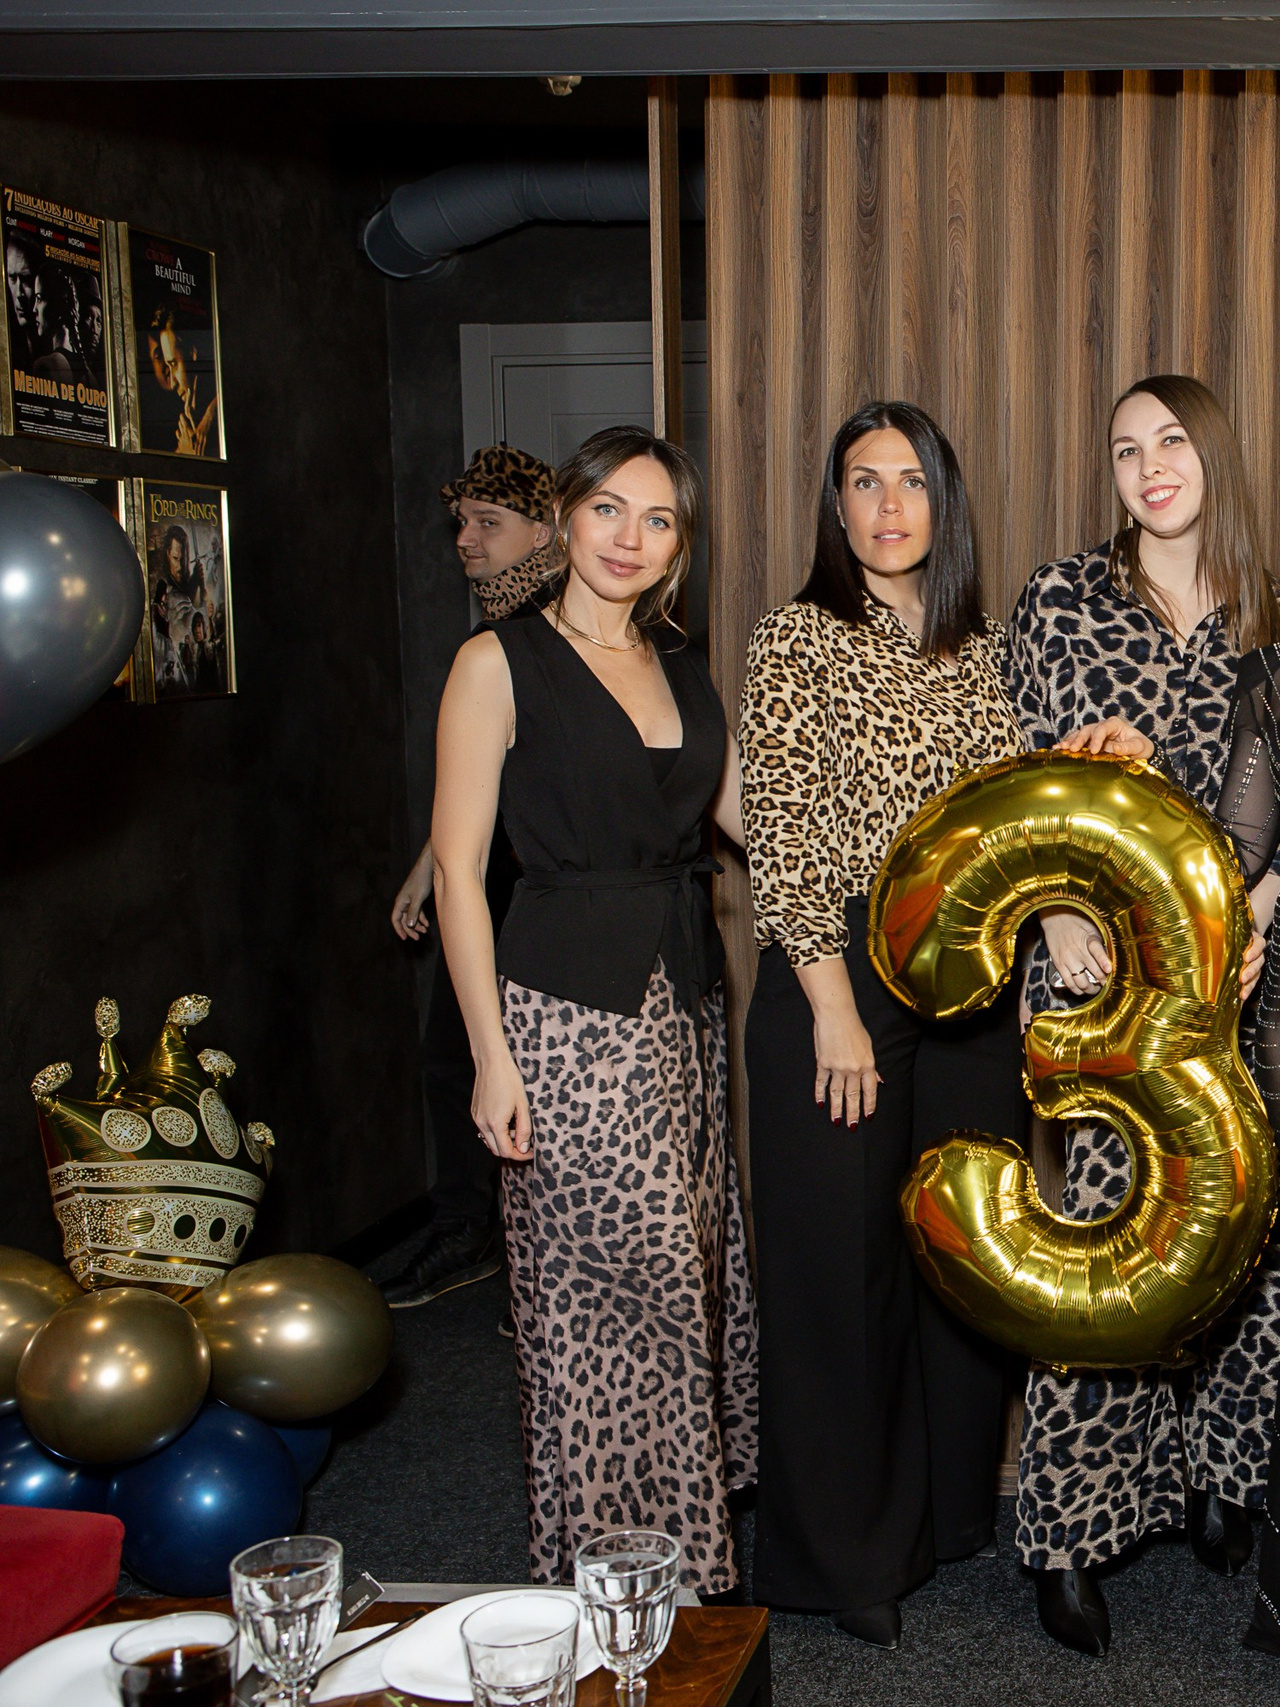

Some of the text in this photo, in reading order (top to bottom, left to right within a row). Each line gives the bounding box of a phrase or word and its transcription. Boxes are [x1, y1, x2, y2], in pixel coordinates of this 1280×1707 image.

[4, 188, 14, 212] 7
[62, 207, 73, 221] AO
[74, 211, 99, 229] OSCAR
[154, 264, 196, 287] BEAUTIFUL
[175, 257, 183, 270] A
[170, 282, 191, 295] MIND
[14, 369, 107, 408] MENINA DE OURO
[150, 493, 179, 523] LORD
[185, 499, 219, 527] RINGS
[867, 749, 1279, 1370] 3
